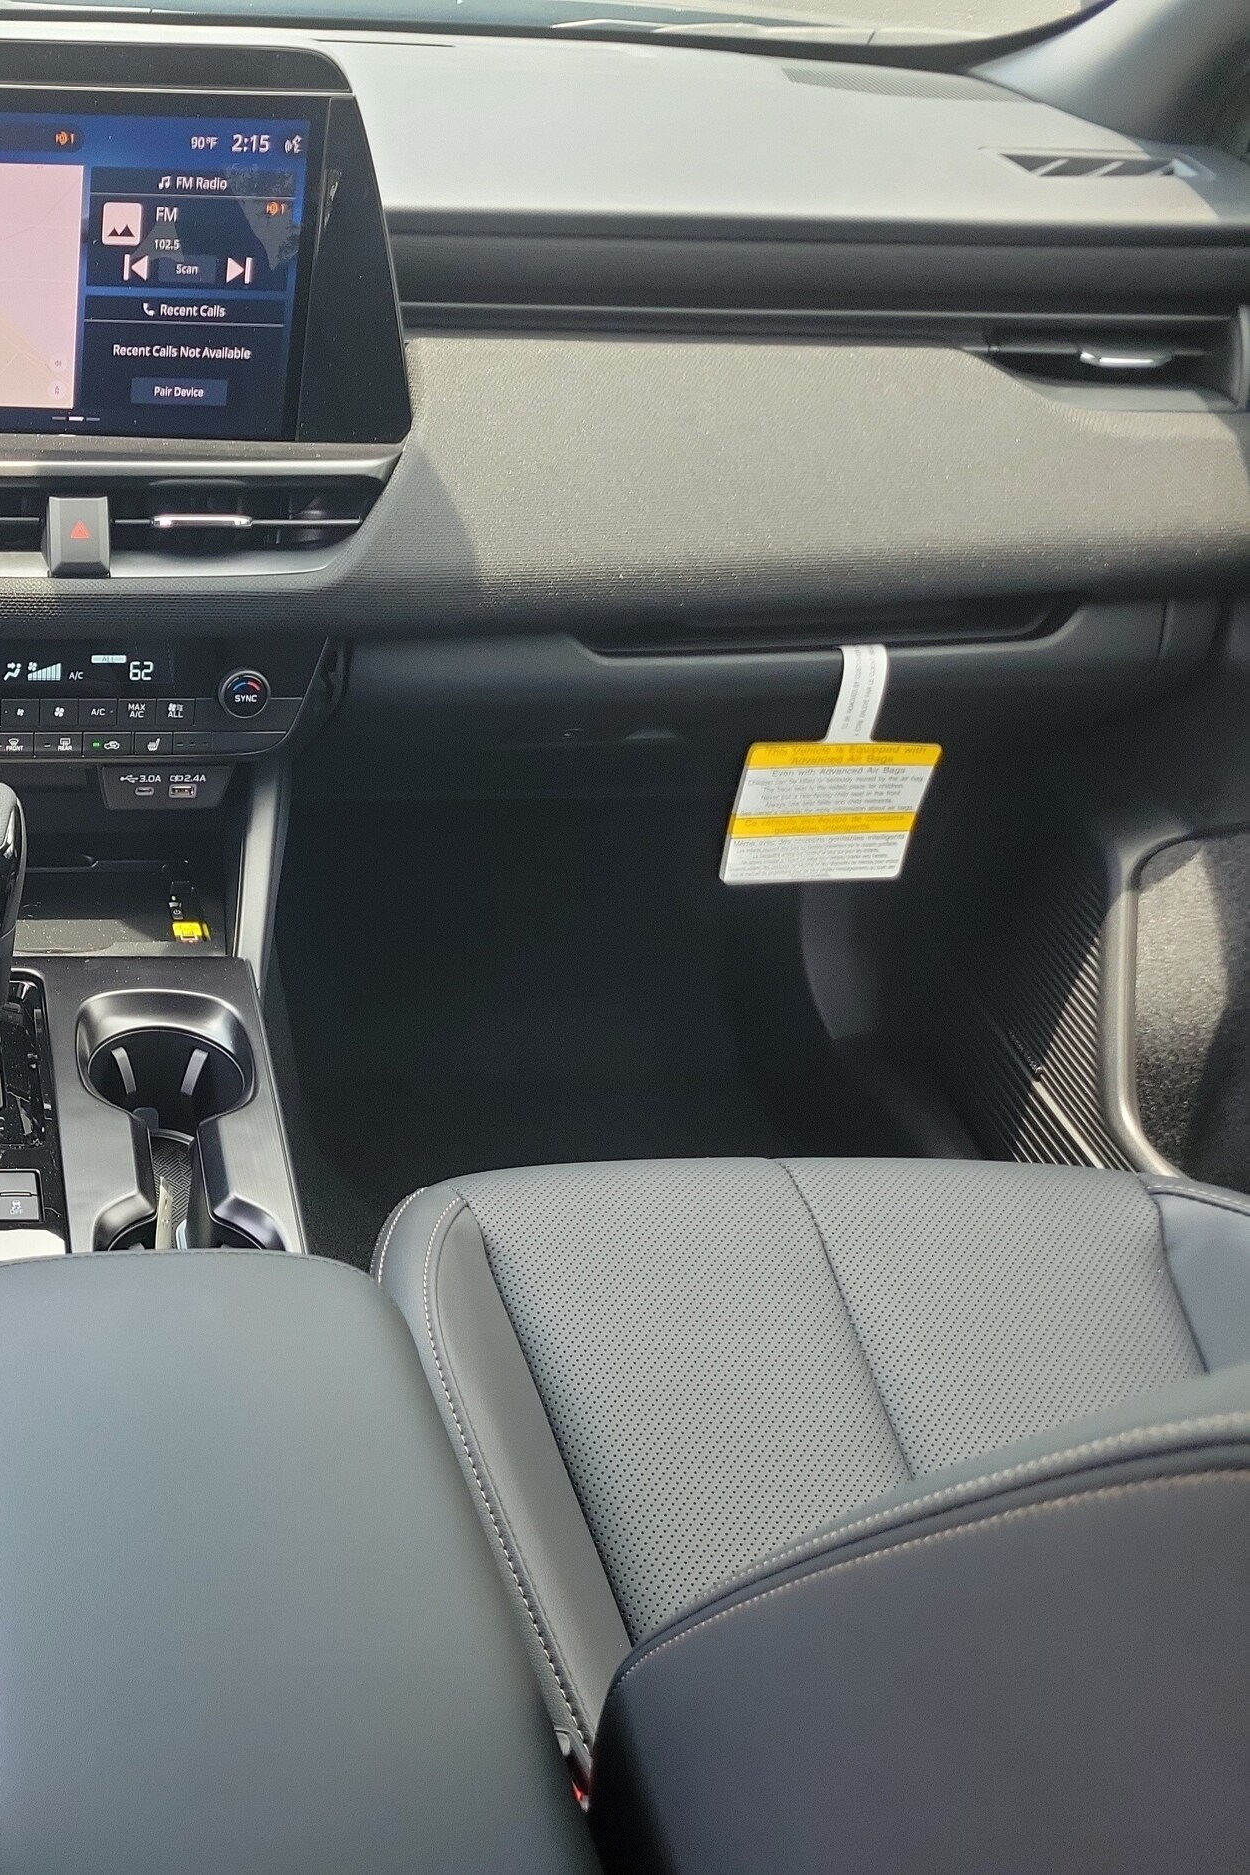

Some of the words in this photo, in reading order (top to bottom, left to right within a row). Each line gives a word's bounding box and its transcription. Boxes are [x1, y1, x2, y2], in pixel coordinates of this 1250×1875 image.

[231, 134, 270, 153] 2:15
[176, 176, 193, 190] FM
[196, 176, 227, 190] Radio
[156, 206, 178, 222] FM
[154, 239, 180, 250] 102.5
[176, 264, 198, 274] Scan
[160, 304, 198, 316] Recent
[200, 305, 226, 317] Calls
[113, 344, 150, 357] Recent
[152, 345, 178, 358] Calls
[180, 346, 200, 358] Not
[202, 347, 251, 360] Available
[154, 386, 172, 397] Pair
[174, 386, 204, 398] Device
[69, 672, 84, 680] A/C
[129, 661, 154, 681] 62
[234, 694, 258, 703] SYNC
[91, 708, 106, 716] A/C
[139, 774, 161, 783] 3.0A
[184, 774, 206, 782] 2.4A
